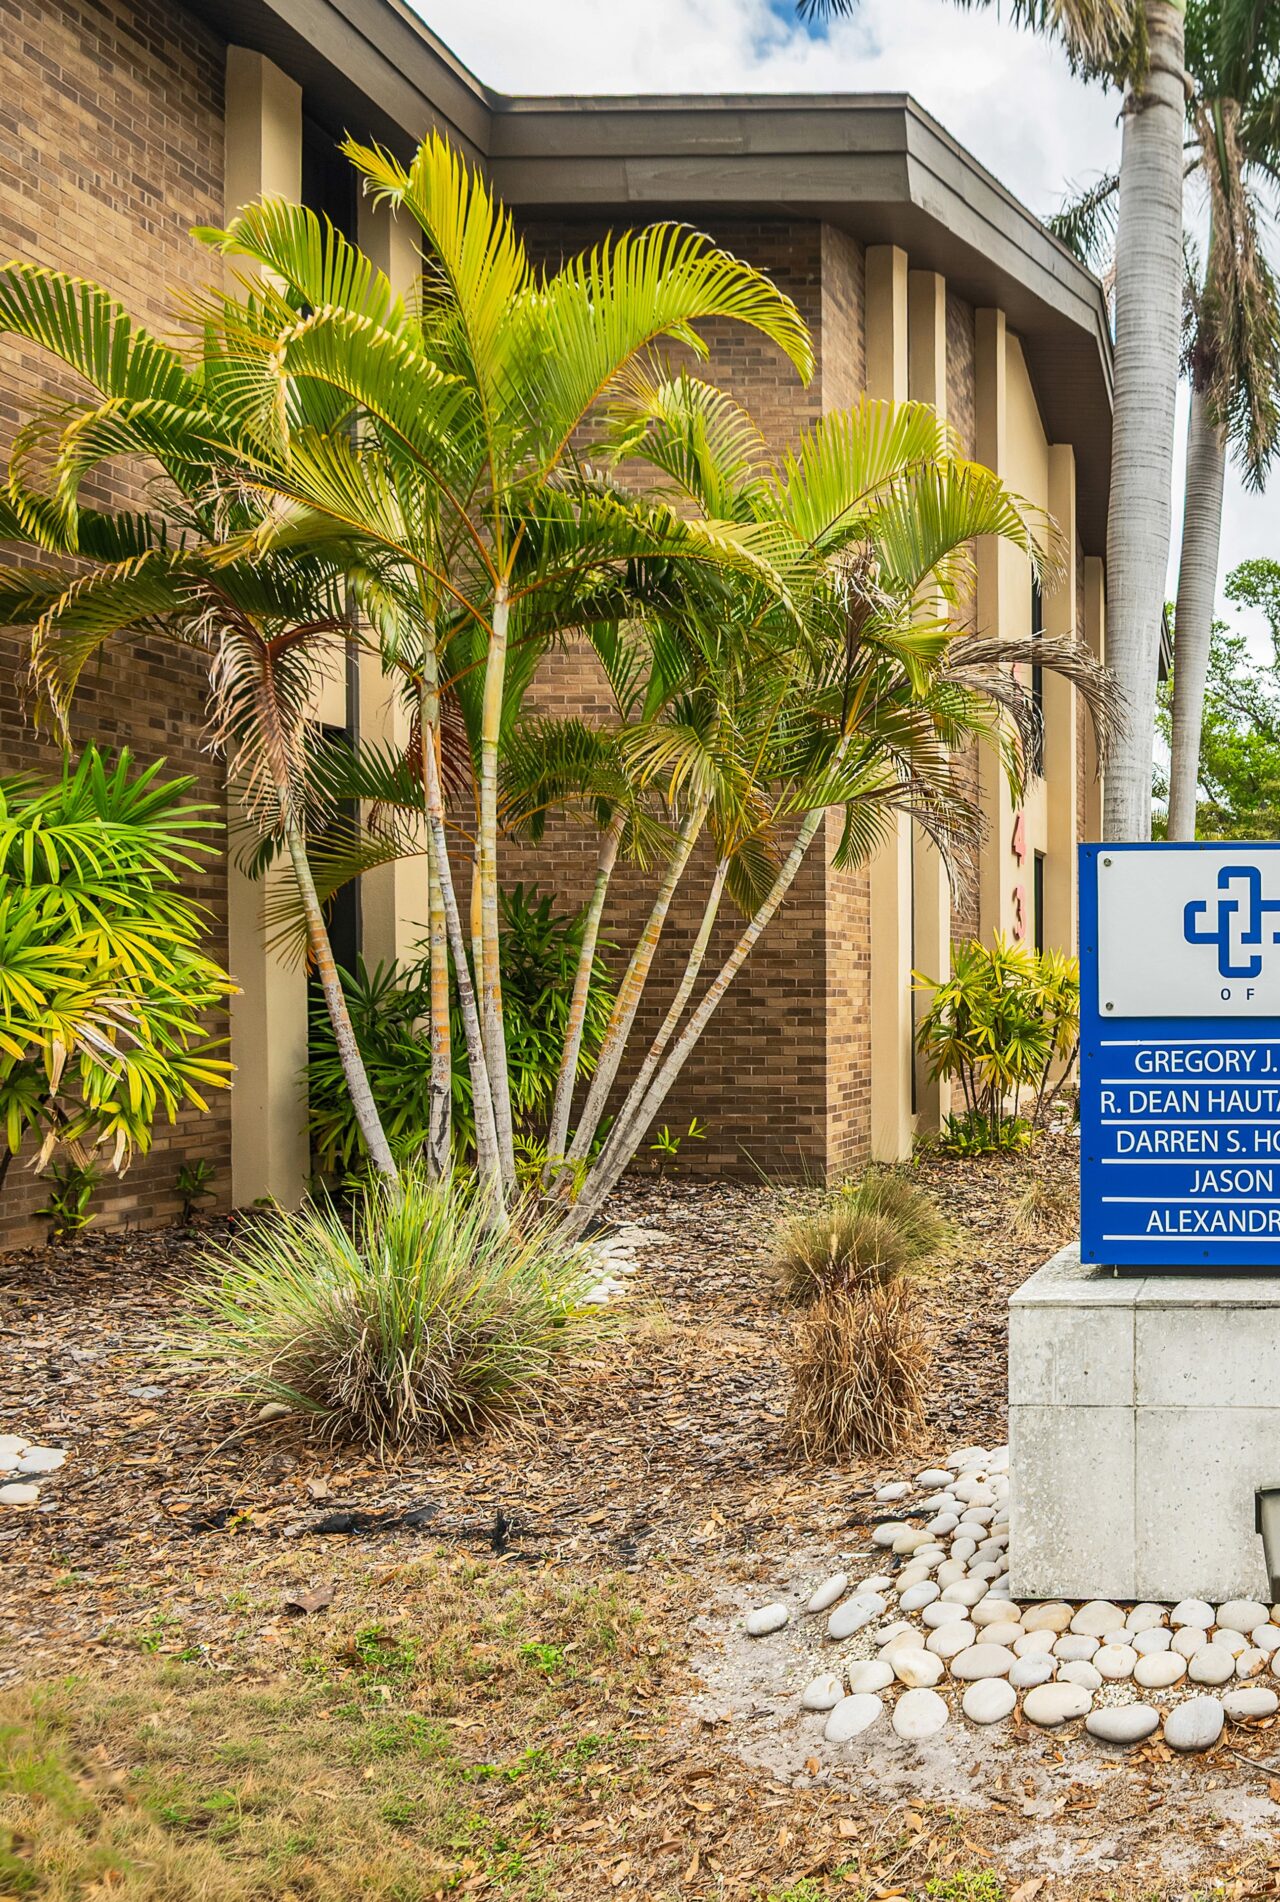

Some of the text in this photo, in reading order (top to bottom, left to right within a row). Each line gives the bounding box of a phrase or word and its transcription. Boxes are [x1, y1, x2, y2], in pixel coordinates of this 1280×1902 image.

[1220, 987, 1256, 1001] OF
[1134, 1049, 1257, 1073] GREGORY
[1260, 1049, 1278, 1073] J.
[1100, 1090, 1122, 1114] R.
[1129, 1090, 1200, 1114] DEAN
[1116, 1130, 1219, 1153] DARREN
[1226, 1129, 1247, 1153] S.
[1189, 1169, 1273, 1193] JASON
